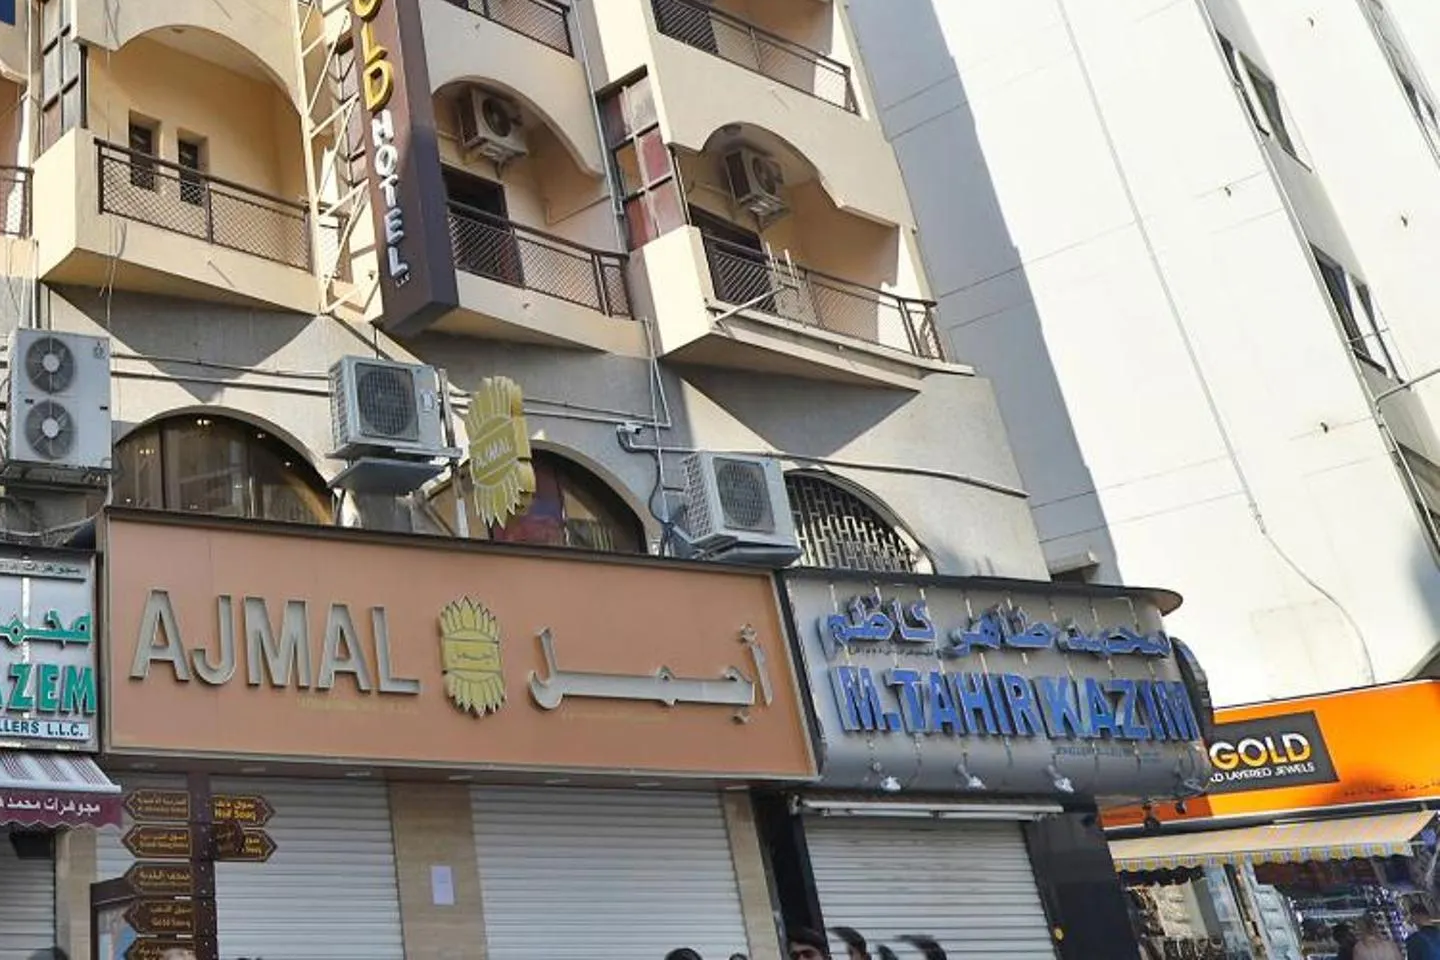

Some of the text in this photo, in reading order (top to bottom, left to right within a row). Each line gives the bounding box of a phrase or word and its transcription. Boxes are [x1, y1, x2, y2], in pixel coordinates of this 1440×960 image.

[372, 108, 408, 276] HOTEL
[129, 589, 422, 696] AJMAL
[527, 622, 773, 726] أجمل
[1040, 676, 1202, 741] KAZIM
[1209, 732, 1312, 771] GOLD
[1274, 761, 1316, 777] JEWELS
[8, 796, 41, 811] محمد
[44, 797, 101, 818] مجوهرات
